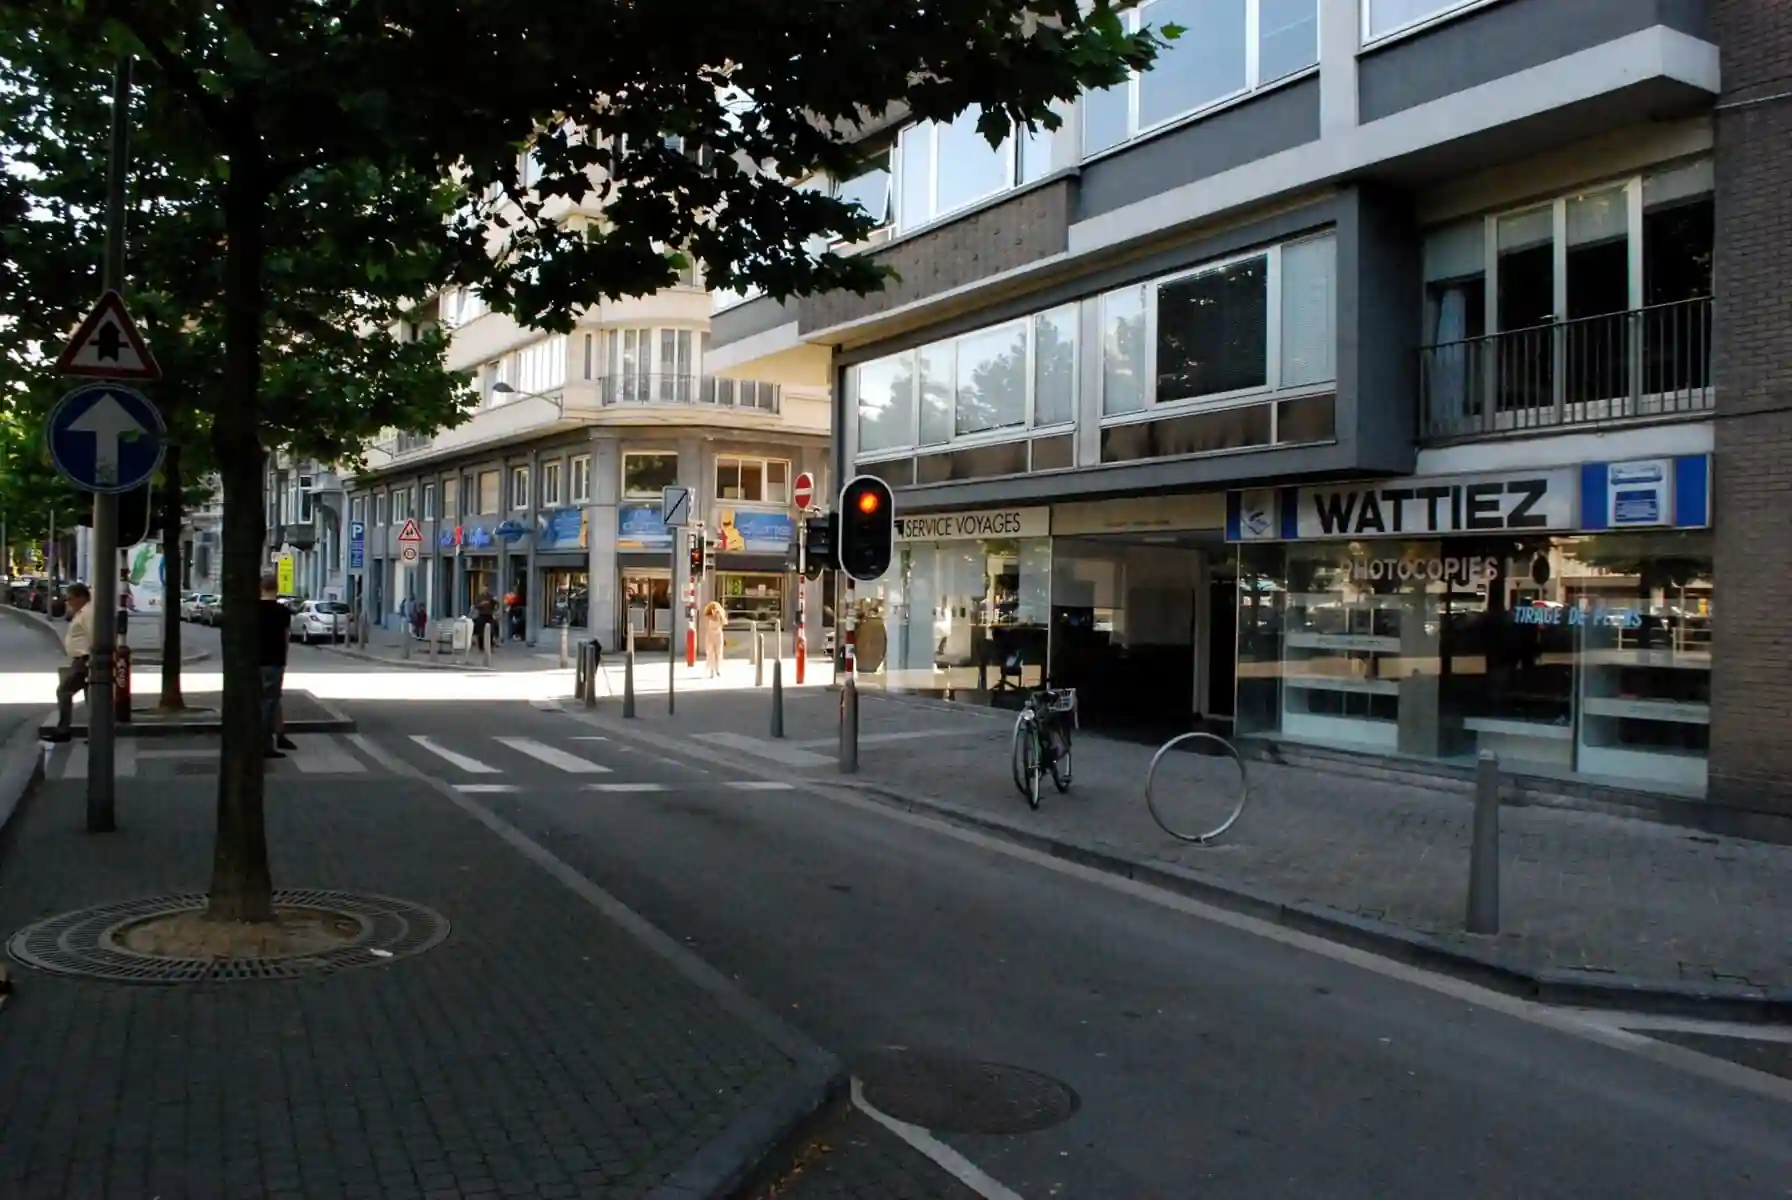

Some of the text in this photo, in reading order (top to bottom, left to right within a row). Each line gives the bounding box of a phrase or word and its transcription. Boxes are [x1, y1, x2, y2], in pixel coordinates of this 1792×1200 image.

[1313, 479, 1548, 534] WATTIEZ
[352, 523, 363, 539] P
[906, 511, 1021, 538] SERVICE VOYAGES
[1340, 556, 1499, 581] PHOTOCOPIES
[1515, 606, 1561, 624] TIRAGE
[1593, 609, 1643, 628] PLNS
